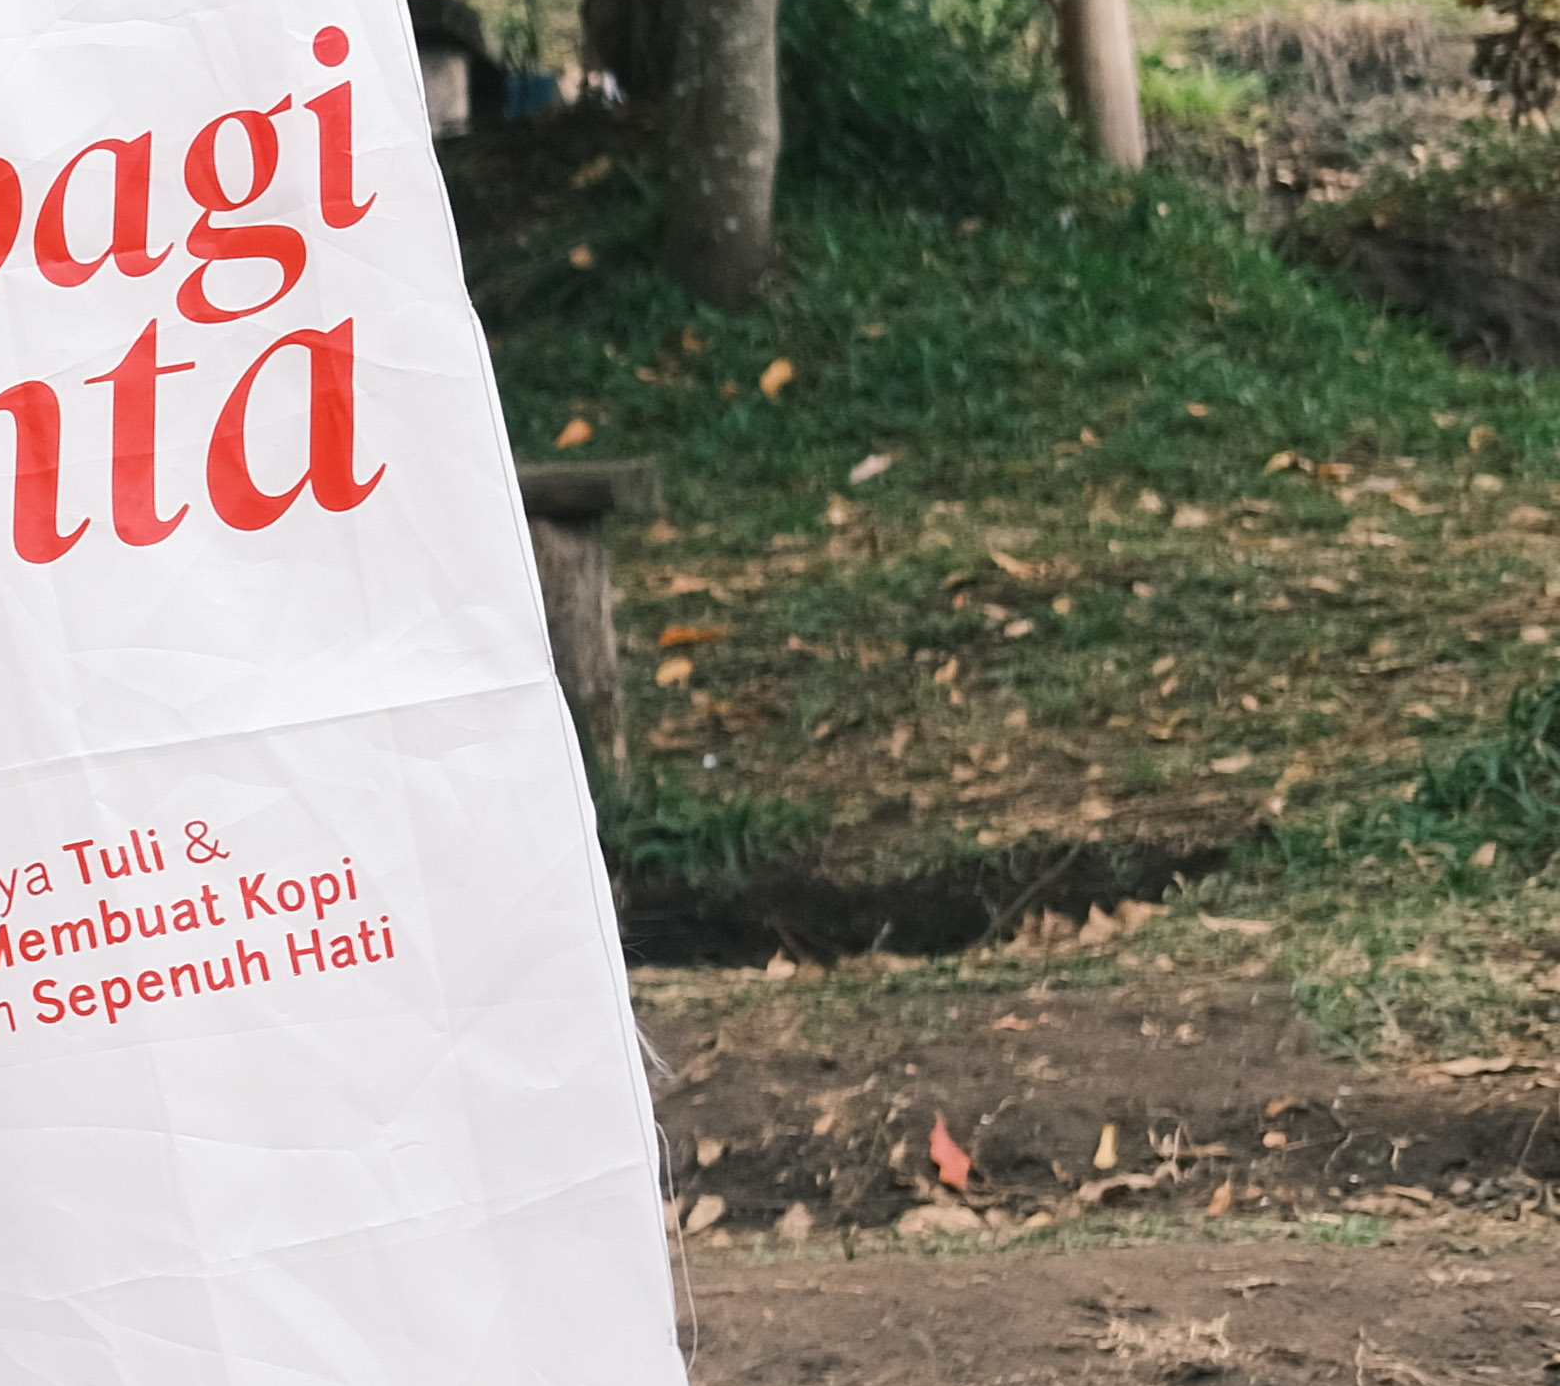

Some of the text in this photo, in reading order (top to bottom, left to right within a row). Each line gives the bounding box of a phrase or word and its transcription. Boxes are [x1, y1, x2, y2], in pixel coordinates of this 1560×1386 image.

[63, 830, 164, 884] Tuli
[184, 820, 231, 865] &
[240, 858, 356, 919] Kopi
[34, 940, 270, 1023] Sepenuh
[288, 916, 394, 975] Hati
